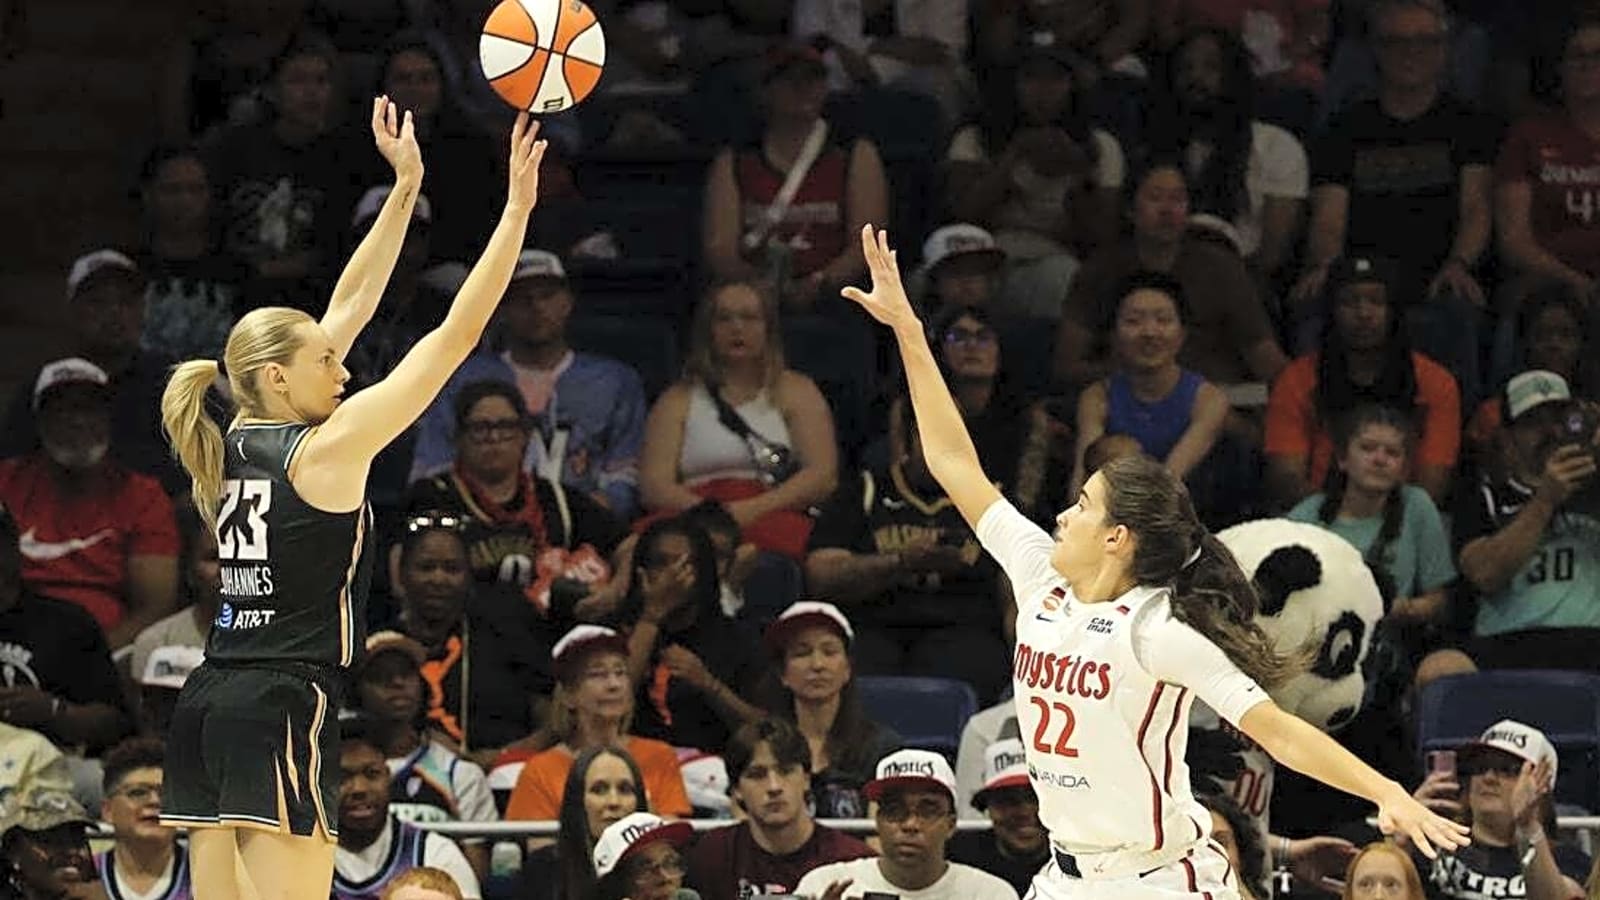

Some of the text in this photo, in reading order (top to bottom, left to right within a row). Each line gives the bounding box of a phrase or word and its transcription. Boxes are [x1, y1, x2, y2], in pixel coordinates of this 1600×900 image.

[216, 479, 272, 560] 23
[233, 609, 276, 631] AT&T
[1030, 696, 1079, 758] 22
